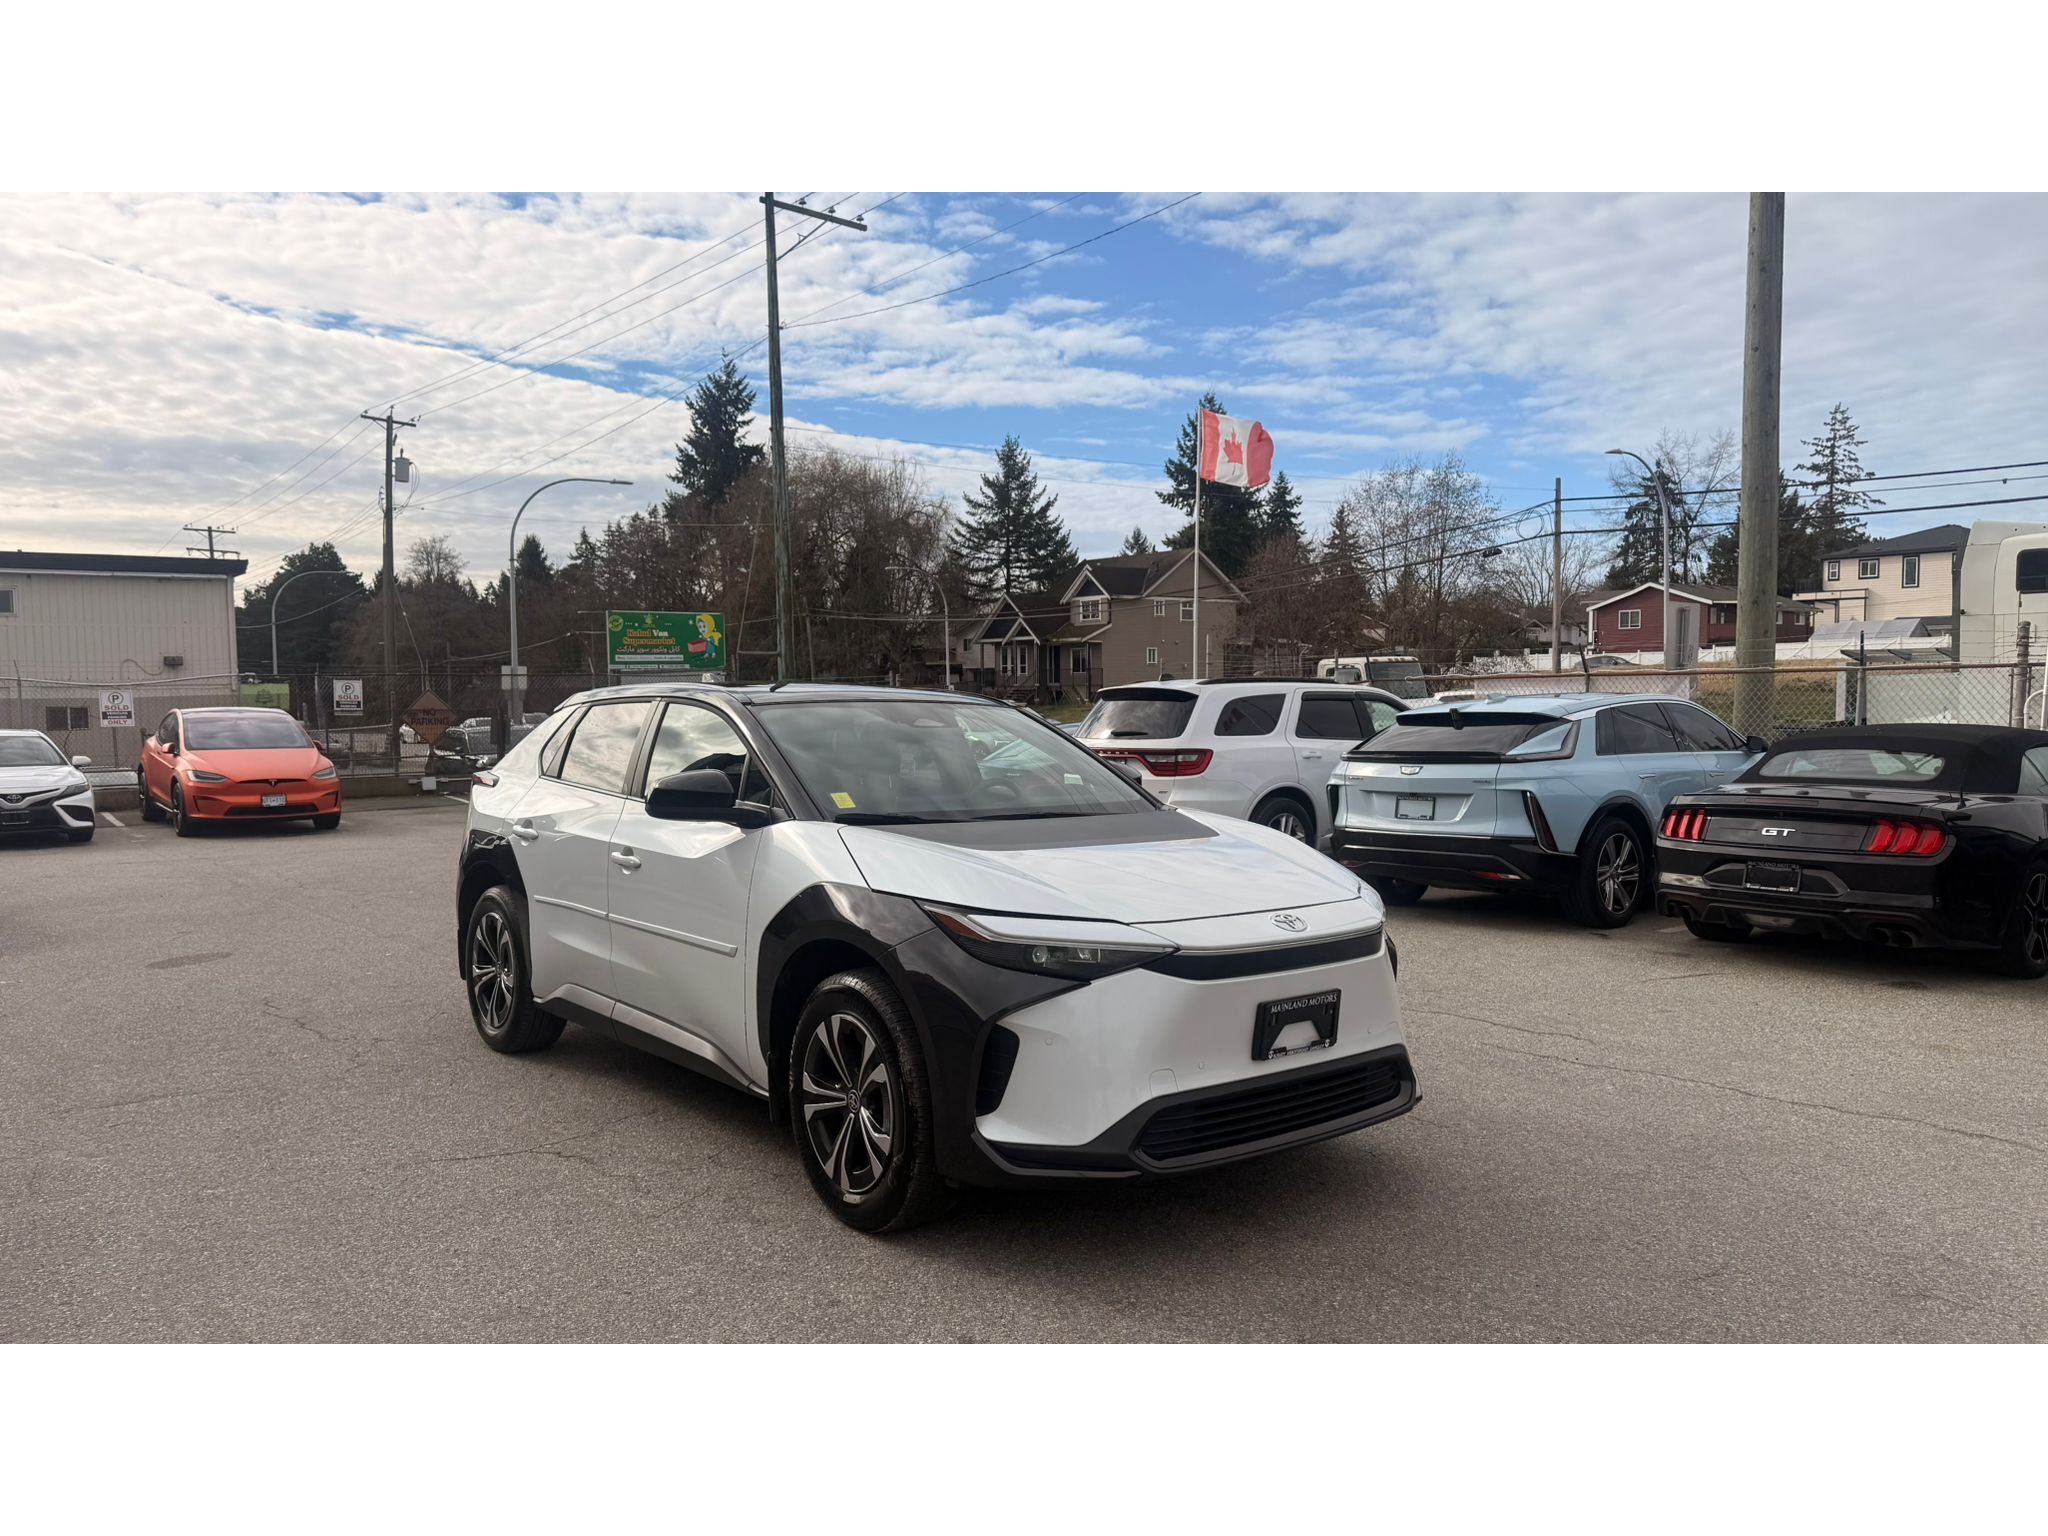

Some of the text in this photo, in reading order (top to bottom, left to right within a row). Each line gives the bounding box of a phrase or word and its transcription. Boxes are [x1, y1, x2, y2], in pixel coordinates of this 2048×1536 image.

[652, 629, 668, 637] Van
[624, 637, 675, 646] Supermarket
[422, 708, 436, 716] NO
[411, 717, 449, 726] PARKING
[1761, 827, 1796, 837] GT
[1271, 994, 1337, 1013] MAINLAND MOTORS
